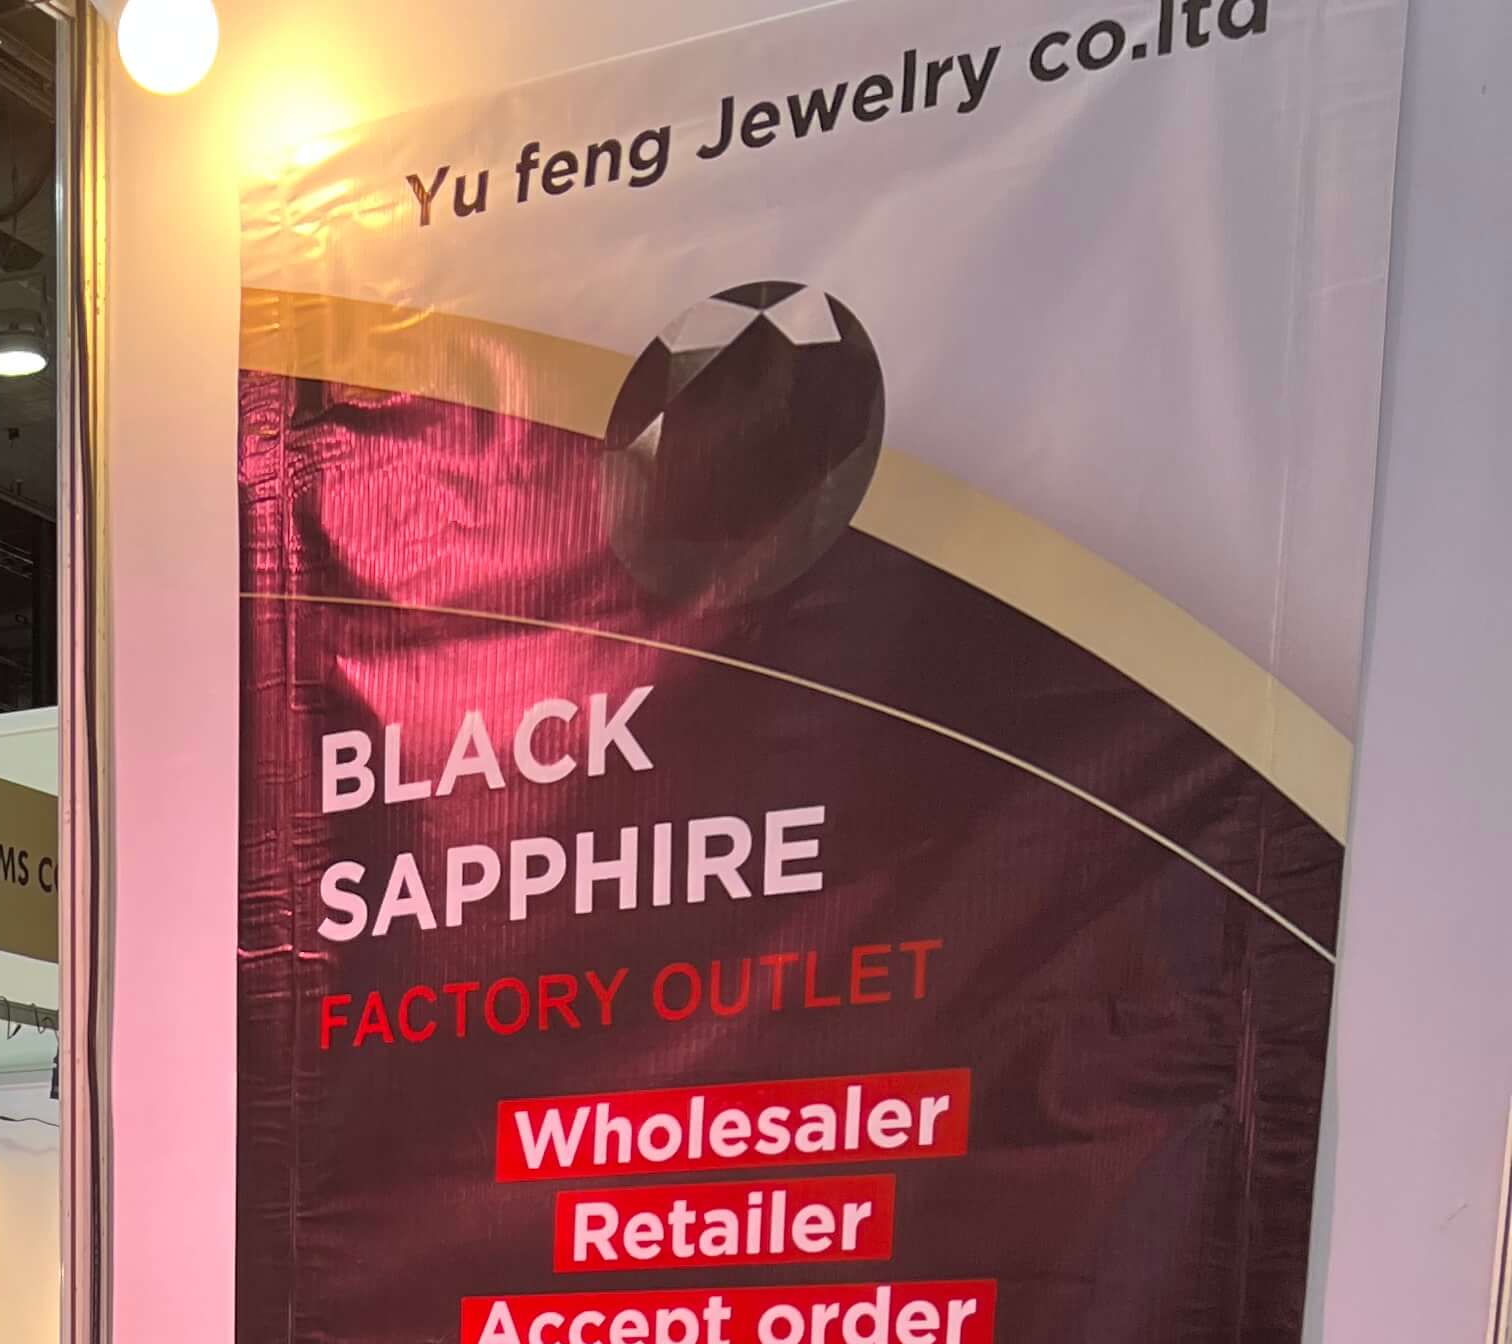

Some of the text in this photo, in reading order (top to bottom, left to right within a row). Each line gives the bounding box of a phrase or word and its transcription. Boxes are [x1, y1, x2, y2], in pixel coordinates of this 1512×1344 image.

[405, 167, 489, 228] Yu
[515, 124, 672, 206] feng
[697, 46, 1001, 161] Jewelry
[321, 685, 655, 813] BLACK
[39, 856, 59, 895] C
[317, 805, 827, 942] SAPPHIRE
[319, 938, 945, 1050] FACTORY OUTLET
[514, 1084, 951, 1171] Wholesaler
[573, 1190, 872, 1263] Retailer
